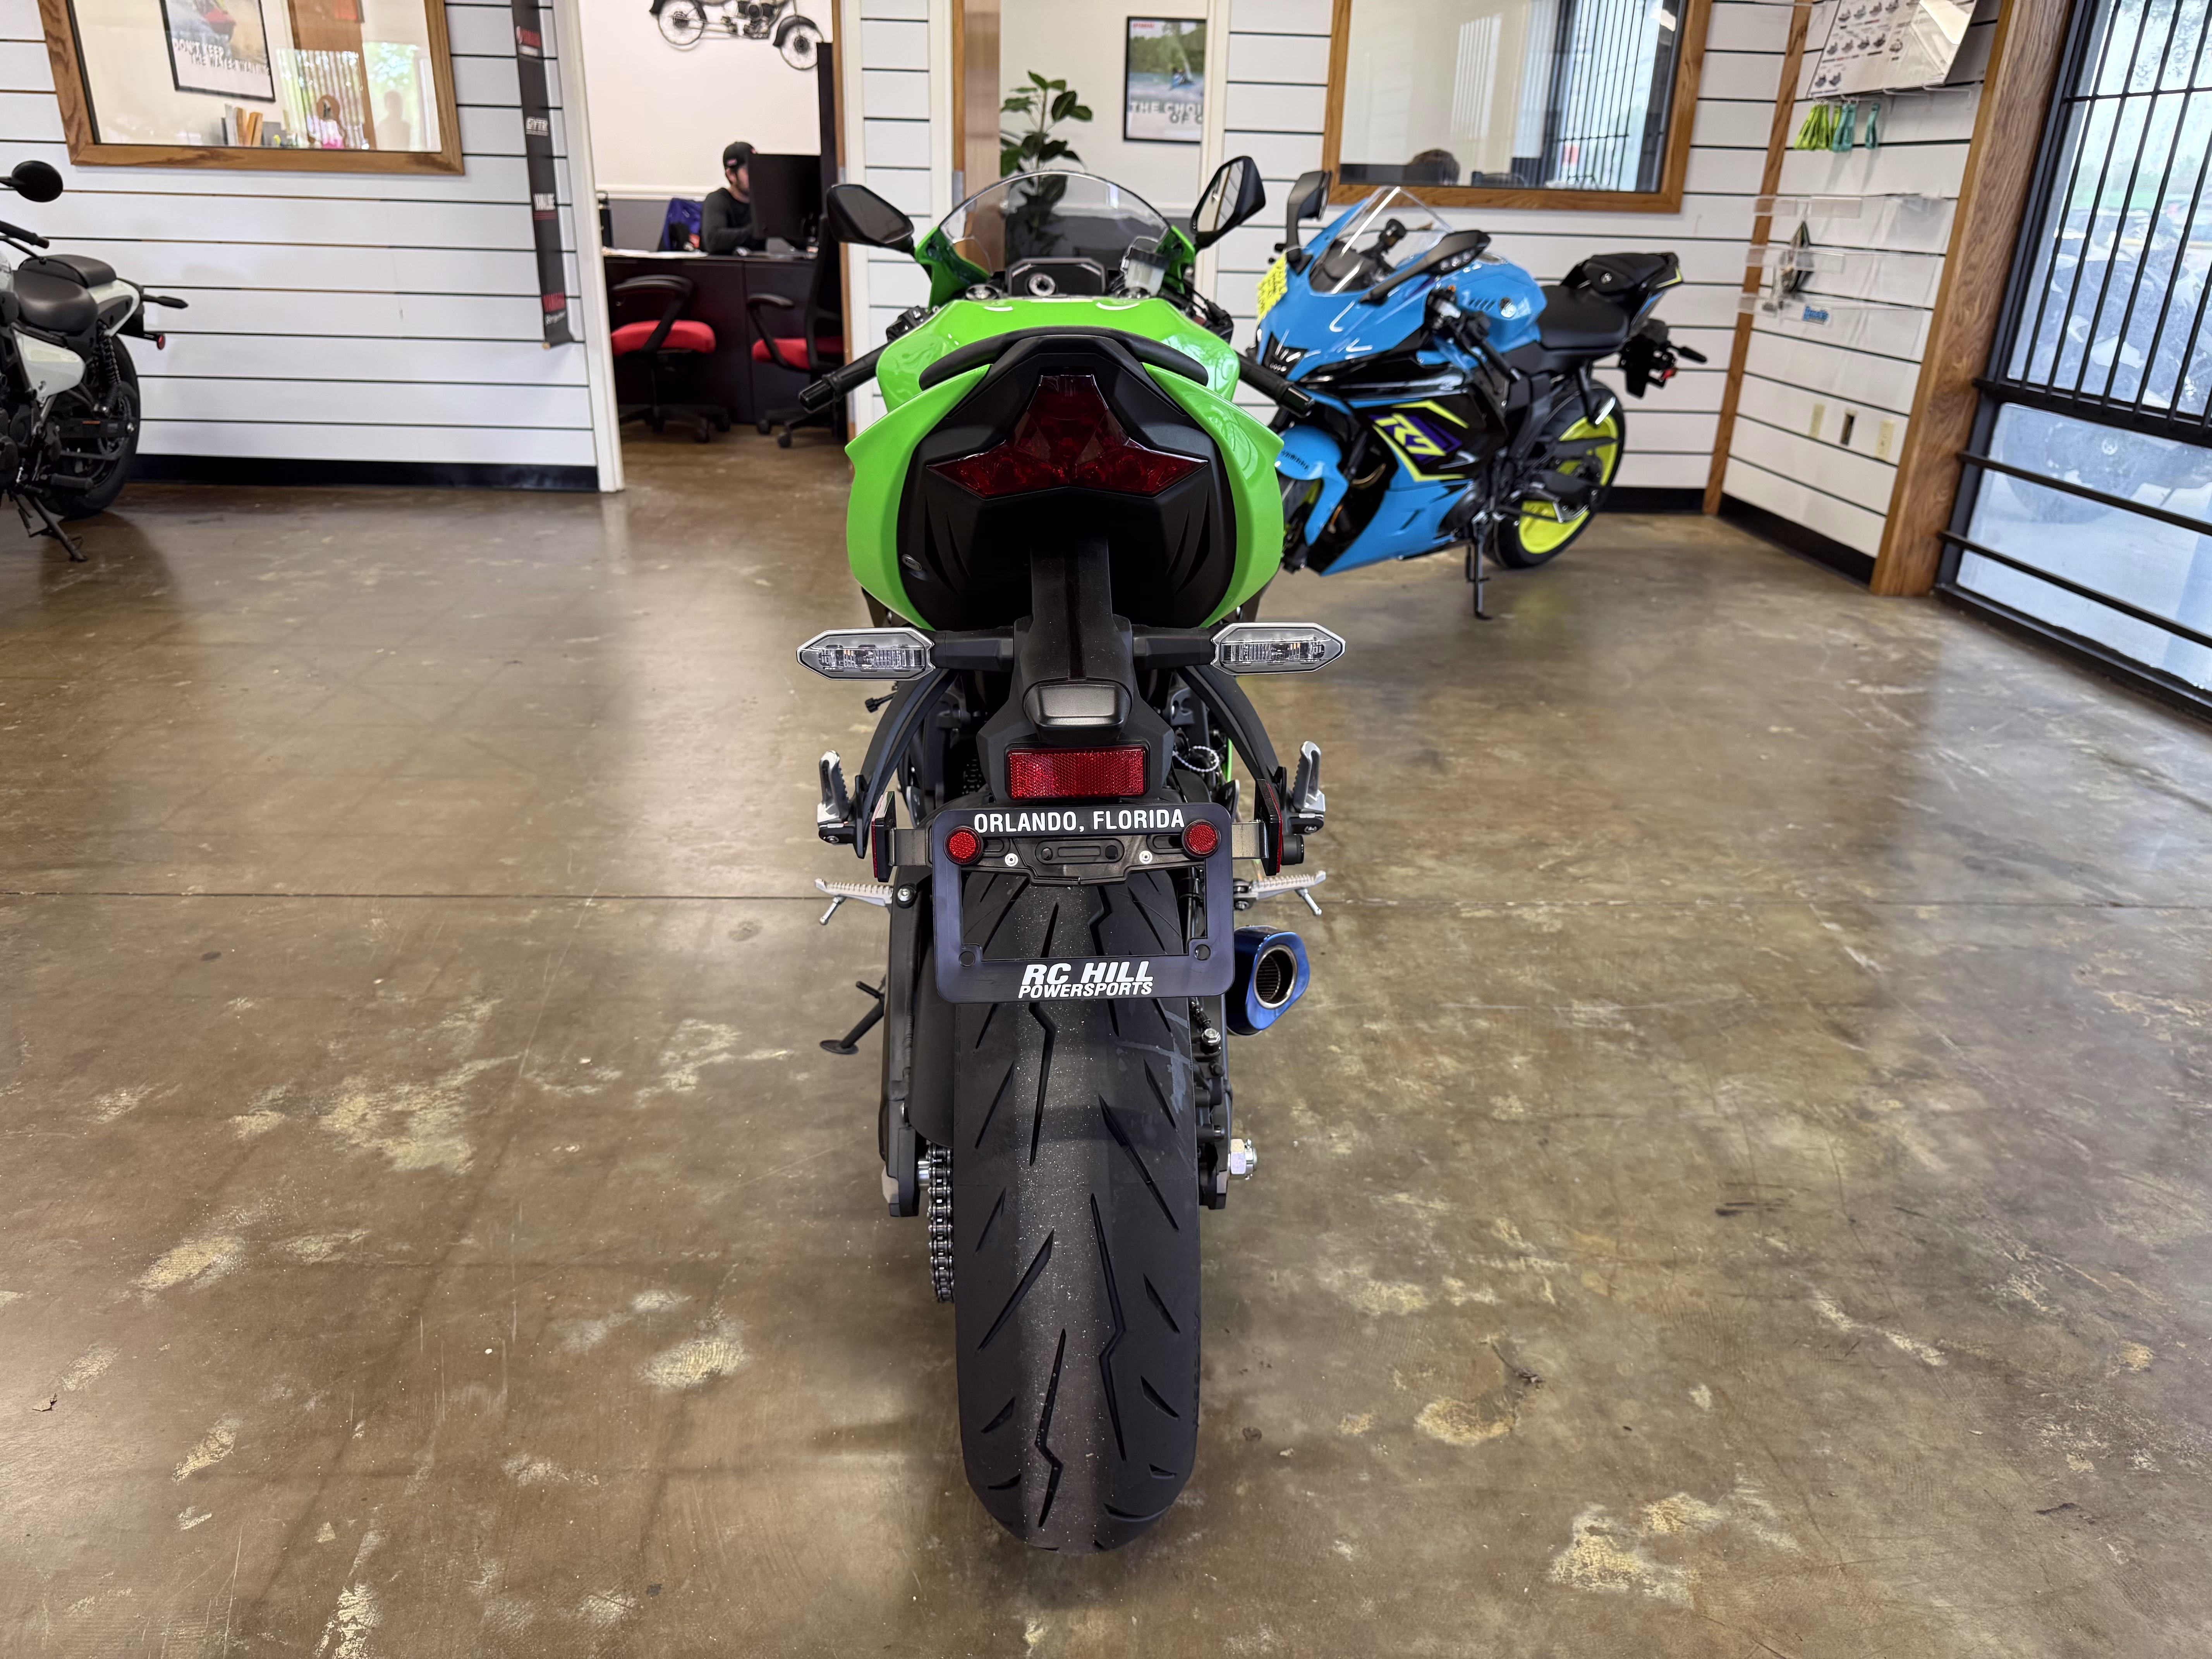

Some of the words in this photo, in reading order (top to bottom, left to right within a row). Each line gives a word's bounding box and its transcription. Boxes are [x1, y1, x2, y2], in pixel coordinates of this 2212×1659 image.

[1132, 102, 1160, 113] THE
[1169, 112, 1190, 124] OF
[1375, 412, 1446, 457] R7
[974, 811, 1084, 833] ORLANDO,
[1093, 809, 1185, 830] FLORIDA
[1022, 963, 1072, 986] RC
[1080, 961, 1154, 984] HILL
[1018, 981, 1154, 999] POWERSPORTS
